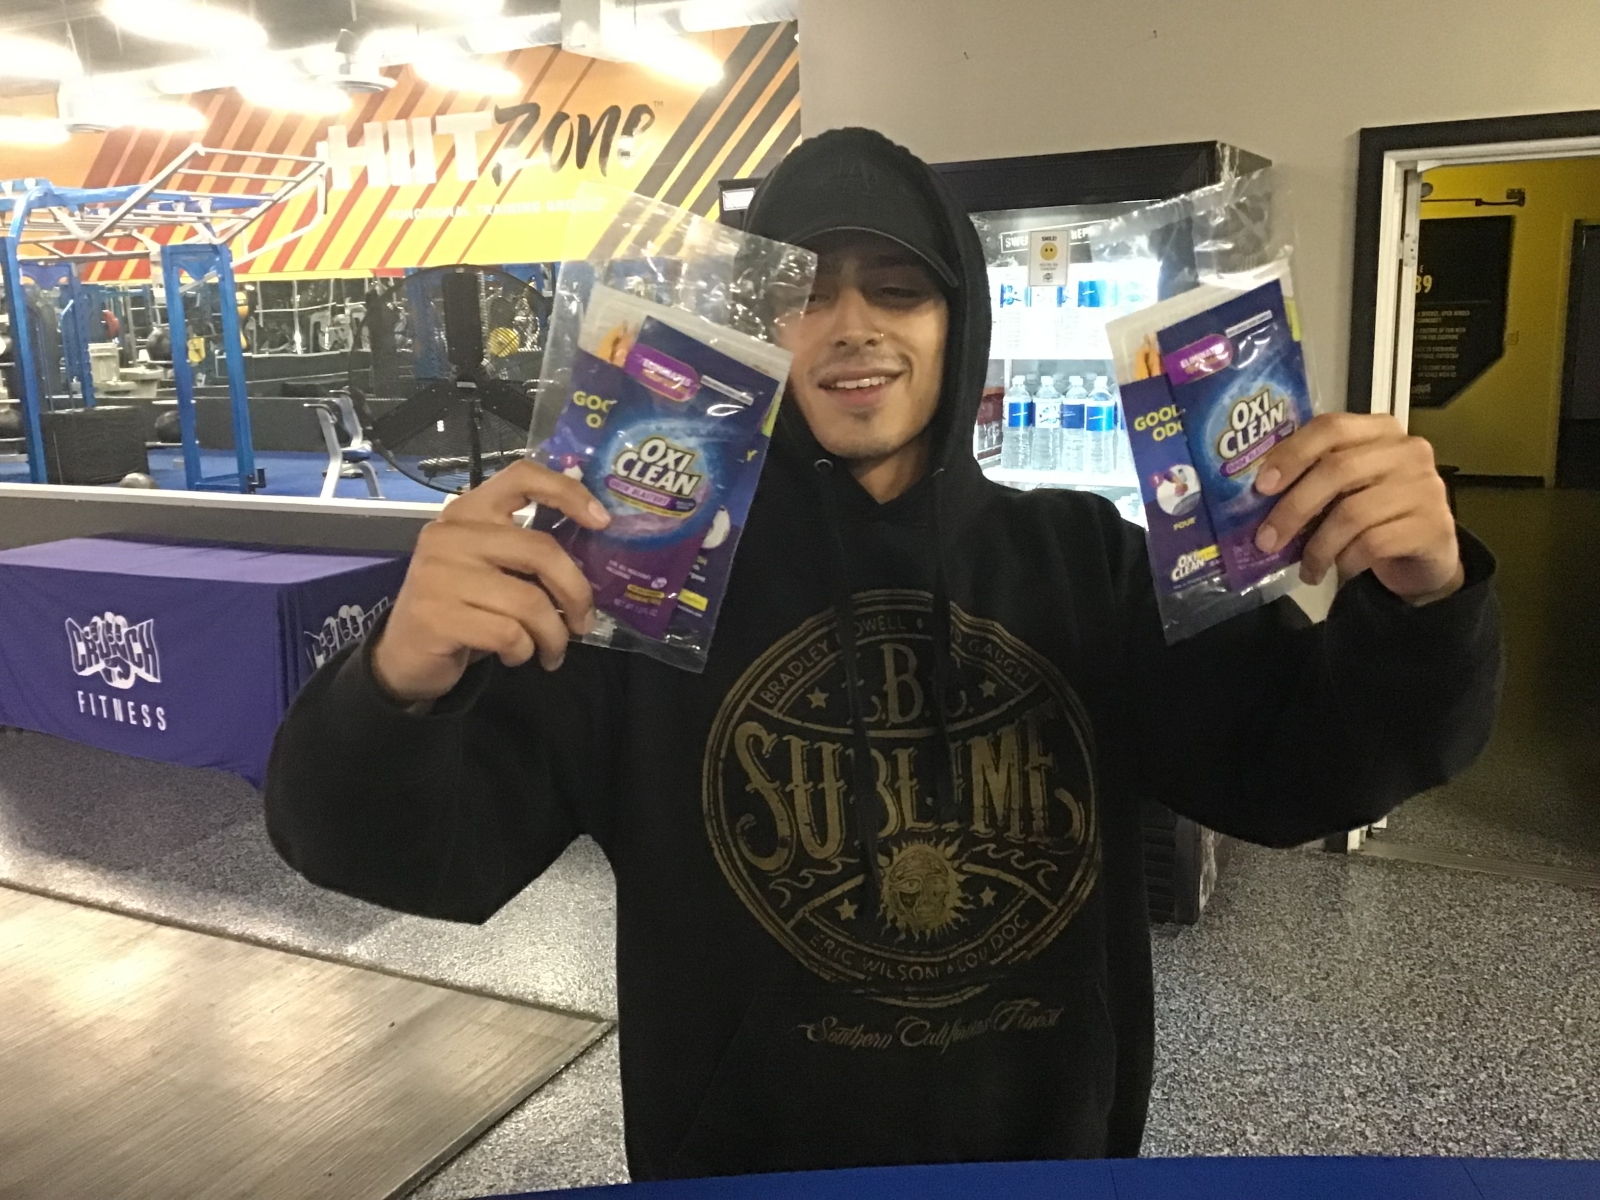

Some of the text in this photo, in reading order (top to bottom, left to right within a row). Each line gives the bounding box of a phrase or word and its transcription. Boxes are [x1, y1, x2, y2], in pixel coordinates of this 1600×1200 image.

[327, 110, 494, 190] HIIT
[1218, 399, 1285, 460] CLEAN
[1231, 389, 1270, 431] OXI
[615, 451, 702, 497] CLEAN
[640, 437, 695, 472] OXI
[1170, 559, 1205, 582] CLEAN
[65, 615, 162, 684] CRUNCH
[757, 639, 831, 706] BRADLEY
[77, 690, 167, 731] FITNESS
[809, 932, 854, 968] ERIC
[861, 959, 941, 982] WILSON
[794, 1015, 894, 1050] Southern
